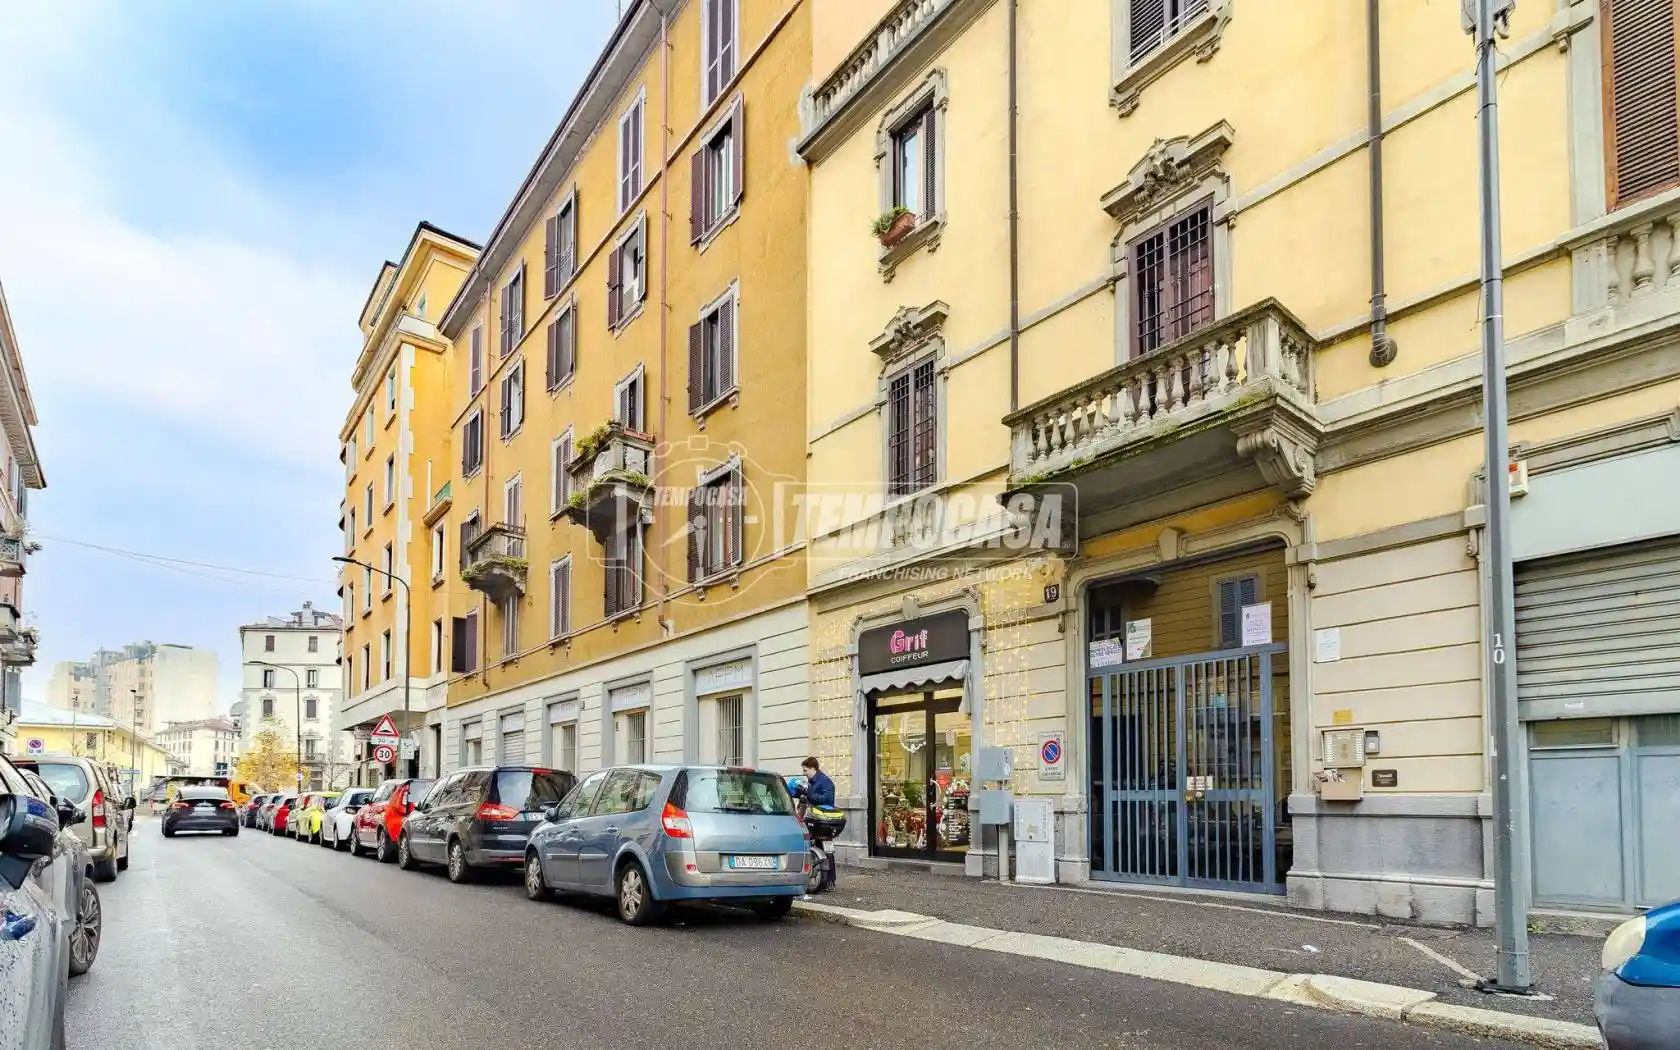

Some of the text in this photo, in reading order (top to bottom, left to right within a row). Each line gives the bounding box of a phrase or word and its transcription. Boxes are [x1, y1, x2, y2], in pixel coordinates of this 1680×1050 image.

[1046, 587, 1057, 599] 19
[890, 629, 929, 655] Grif
[1493, 632, 1506, 665] 10
[890, 650, 929, 664] COIFFEUR
[379, 750, 390, 759] 30
